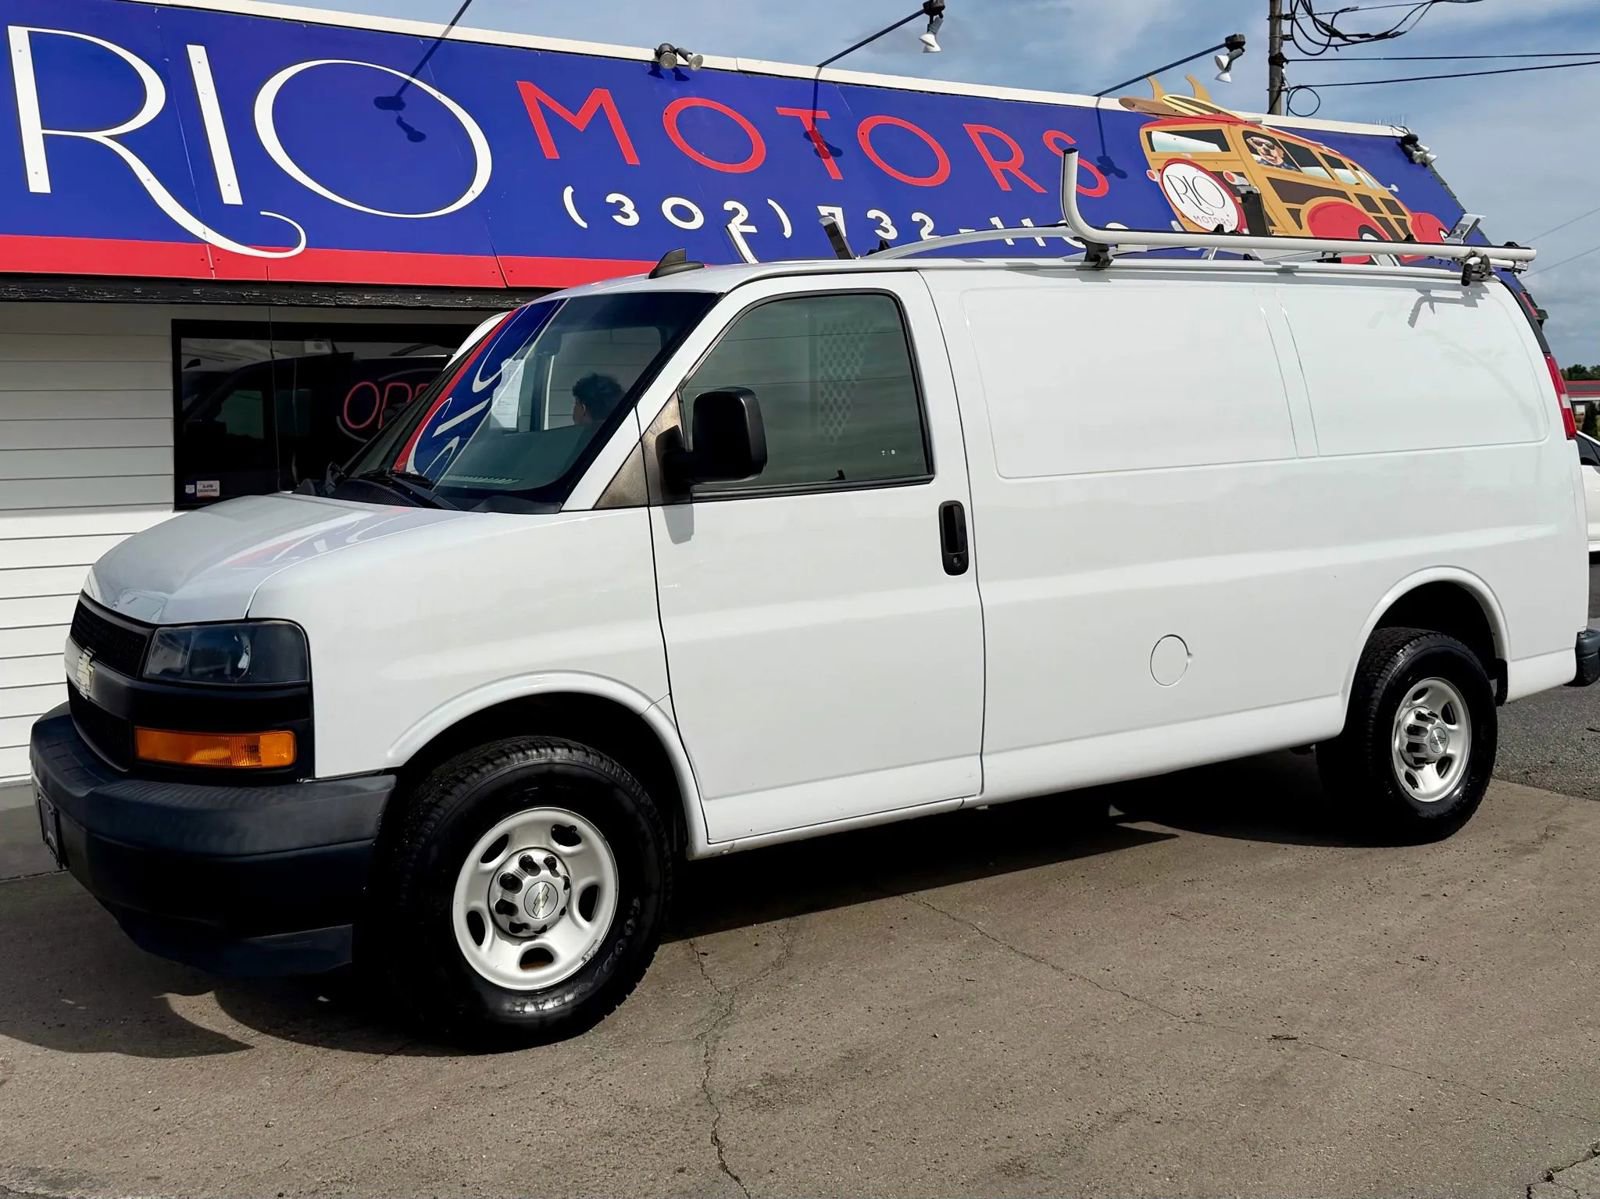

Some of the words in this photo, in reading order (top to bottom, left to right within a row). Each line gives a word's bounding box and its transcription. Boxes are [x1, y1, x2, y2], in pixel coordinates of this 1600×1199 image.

[7, 25, 493, 258] RIO
[516, 80, 1110, 198] MOTORS
[563, 185, 793, 238] (302)
[817, 205, 1129, 249] 732-11
[1165, 173, 1226, 216] RIO
[1193, 213, 1234, 228] MOTORS
